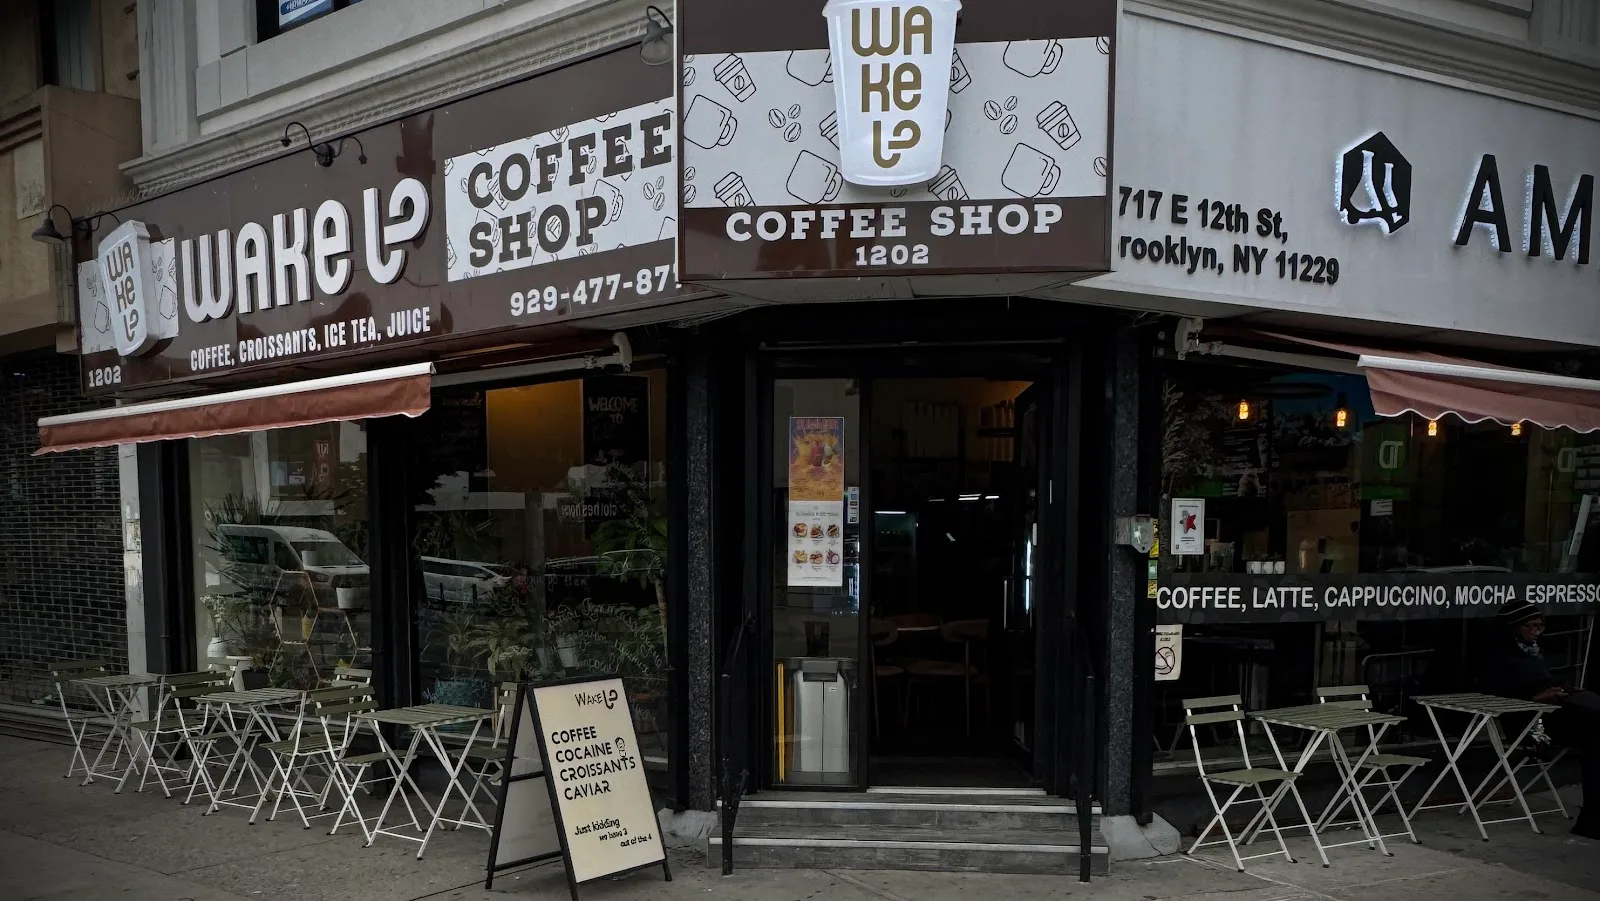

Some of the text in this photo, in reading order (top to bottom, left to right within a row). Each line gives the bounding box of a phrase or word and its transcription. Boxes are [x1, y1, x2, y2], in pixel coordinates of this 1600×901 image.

[851, 5, 934, 57] WA
[467, 112, 672, 209] COFFEE
[469, 195, 608, 269] SHOP
[725, 203, 1063, 242] COFFEE SHOP
[1171, 194, 1188, 225] E
[1198, 199, 1249, 234] 12th
[1257, 209, 1289, 244] St,
[855, 243, 930, 267] 1202
[1118, 234, 1340, 286] rooklyn, NY 11229
[509, 263, 679, 317] 929-477-87
[190, 306, 431, 372] COFFEE, CROISSANTS, ICE TEA, JUICE
[88, 364, 122, 388] 1202
[1156, 585, 1247, 612] COFFEE,
[1252, 585, 1319, 612] LATTE,
[1324, 584, 1451, 610] CAPPUCCINO,
[551, 725, 597, 745] COFFEE
[555, 742, 613, 763] COCAINE
[560, 756, 636, 782] CROISSANTS
[564, 780, 612, 801] CAVIAR
[574, 818, 621, 836] Just kidding
